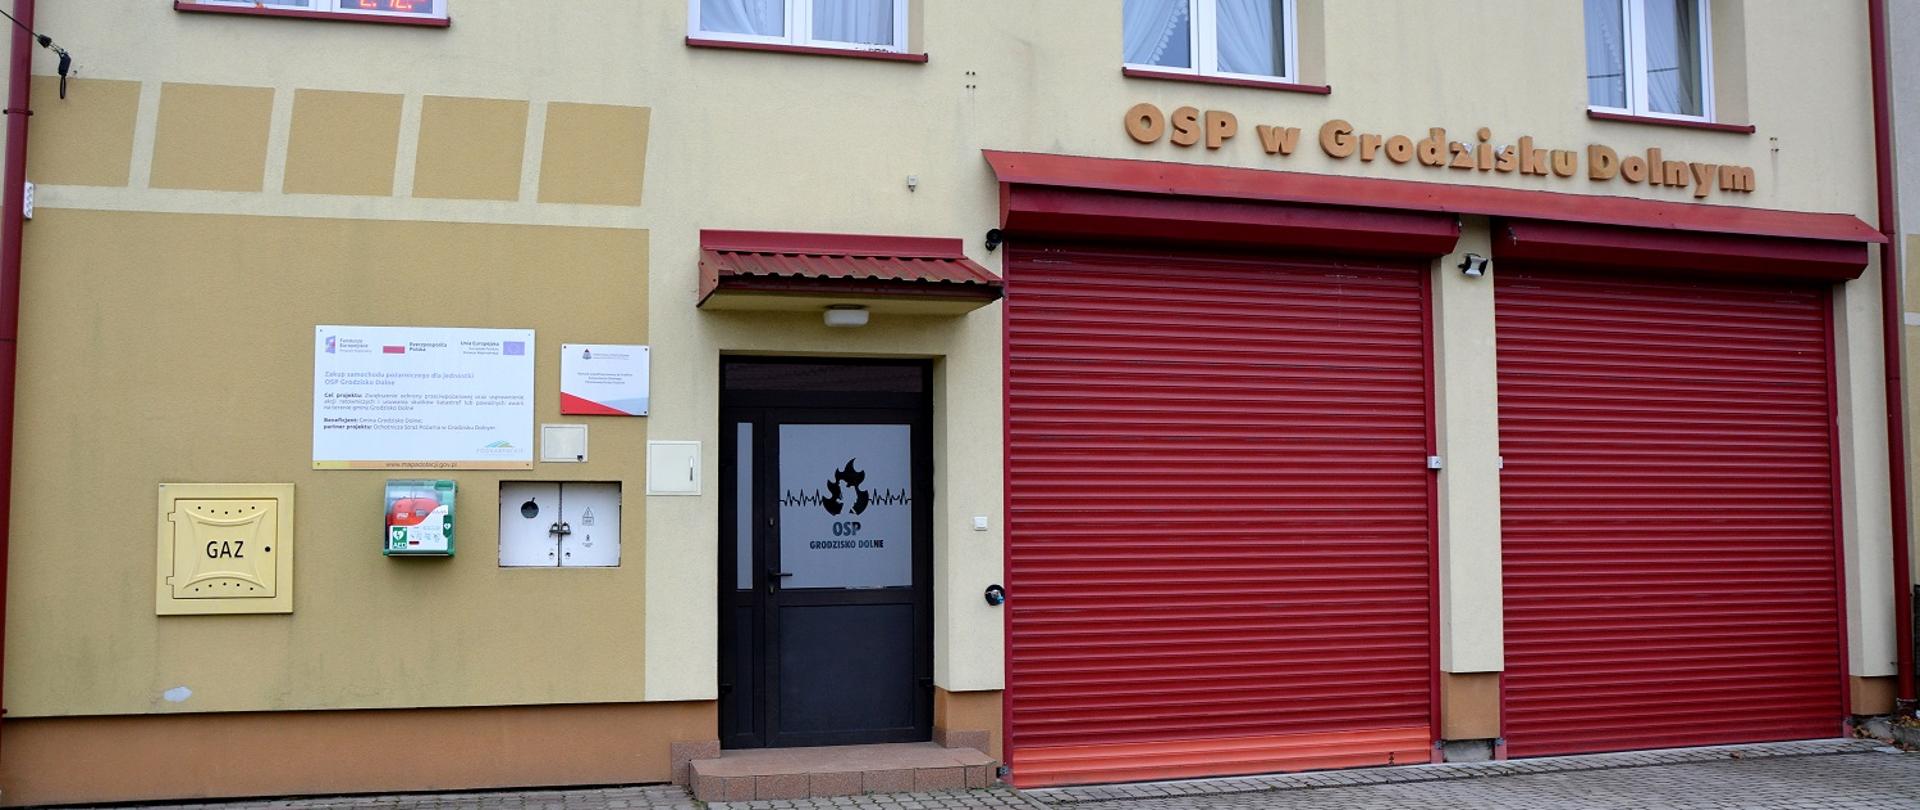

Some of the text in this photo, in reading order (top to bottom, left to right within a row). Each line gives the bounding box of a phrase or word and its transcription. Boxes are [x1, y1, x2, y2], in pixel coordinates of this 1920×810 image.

[1124, 103, 1756, 198] OSP w Grodzisku Dolnym
[832, 521, 861, 537] OSP
[206, 541, 244, 558] GAZ
[809, 539, 884, 550] GRODZISKO DOLNE
